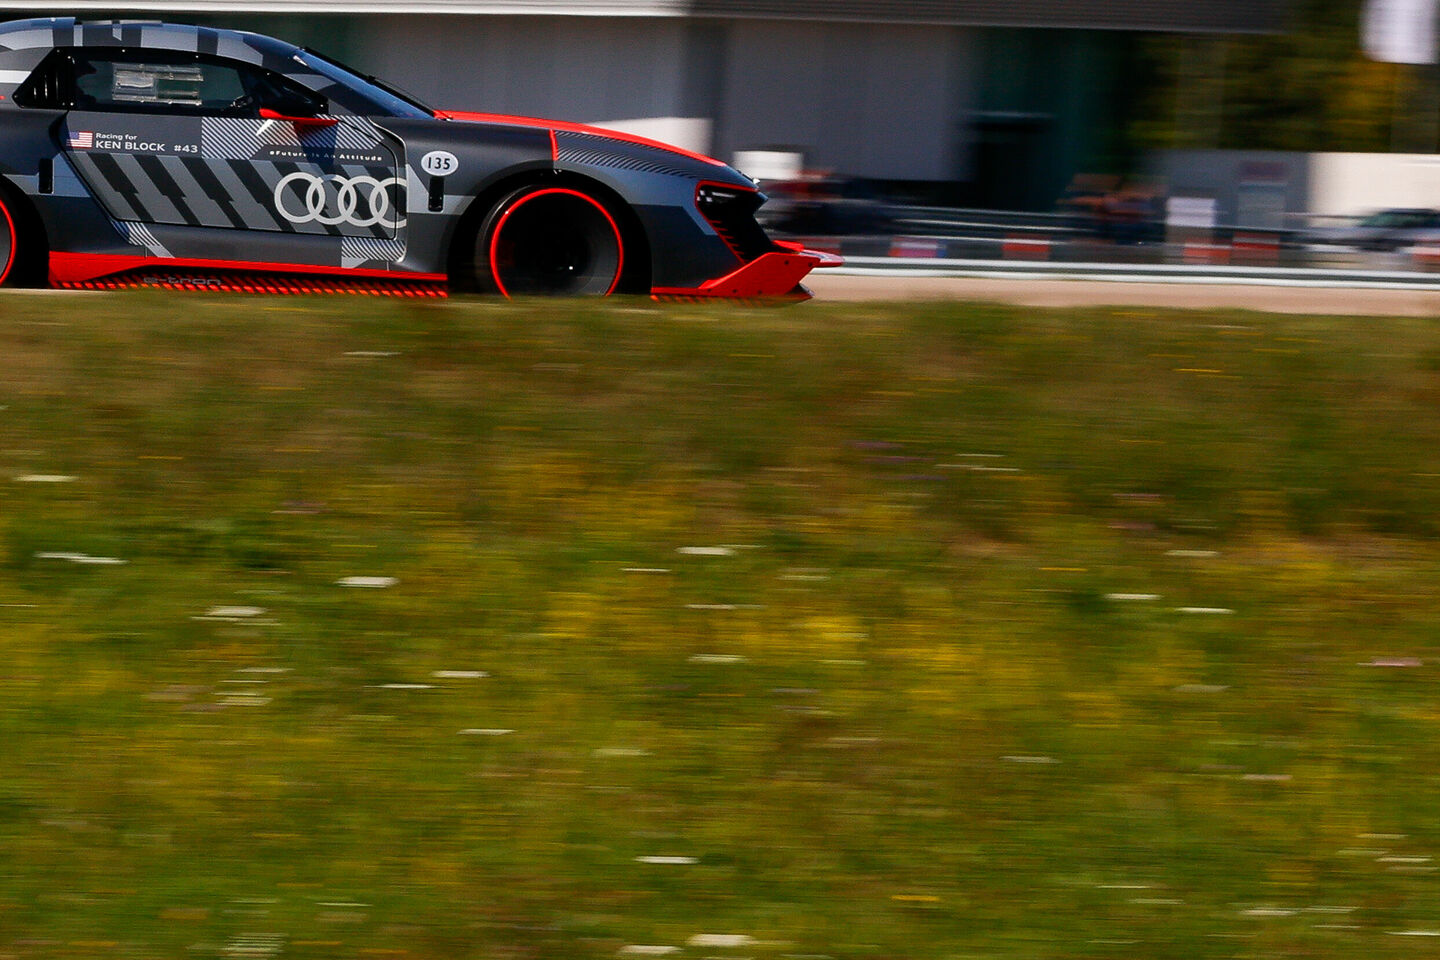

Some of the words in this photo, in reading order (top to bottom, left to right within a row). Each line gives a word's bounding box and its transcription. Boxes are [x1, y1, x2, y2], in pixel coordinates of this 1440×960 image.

[95, 132, 122, 140] Racing
[95, 141, 121, 149] KEN
[124, 142, 165, 151] BLOCK
[173, 144, 198, 153] #43
[339, 153, 383, 161] Attitude
[427, 156, 451, 170] 135
[143, 277, 221, 286] e-tron
